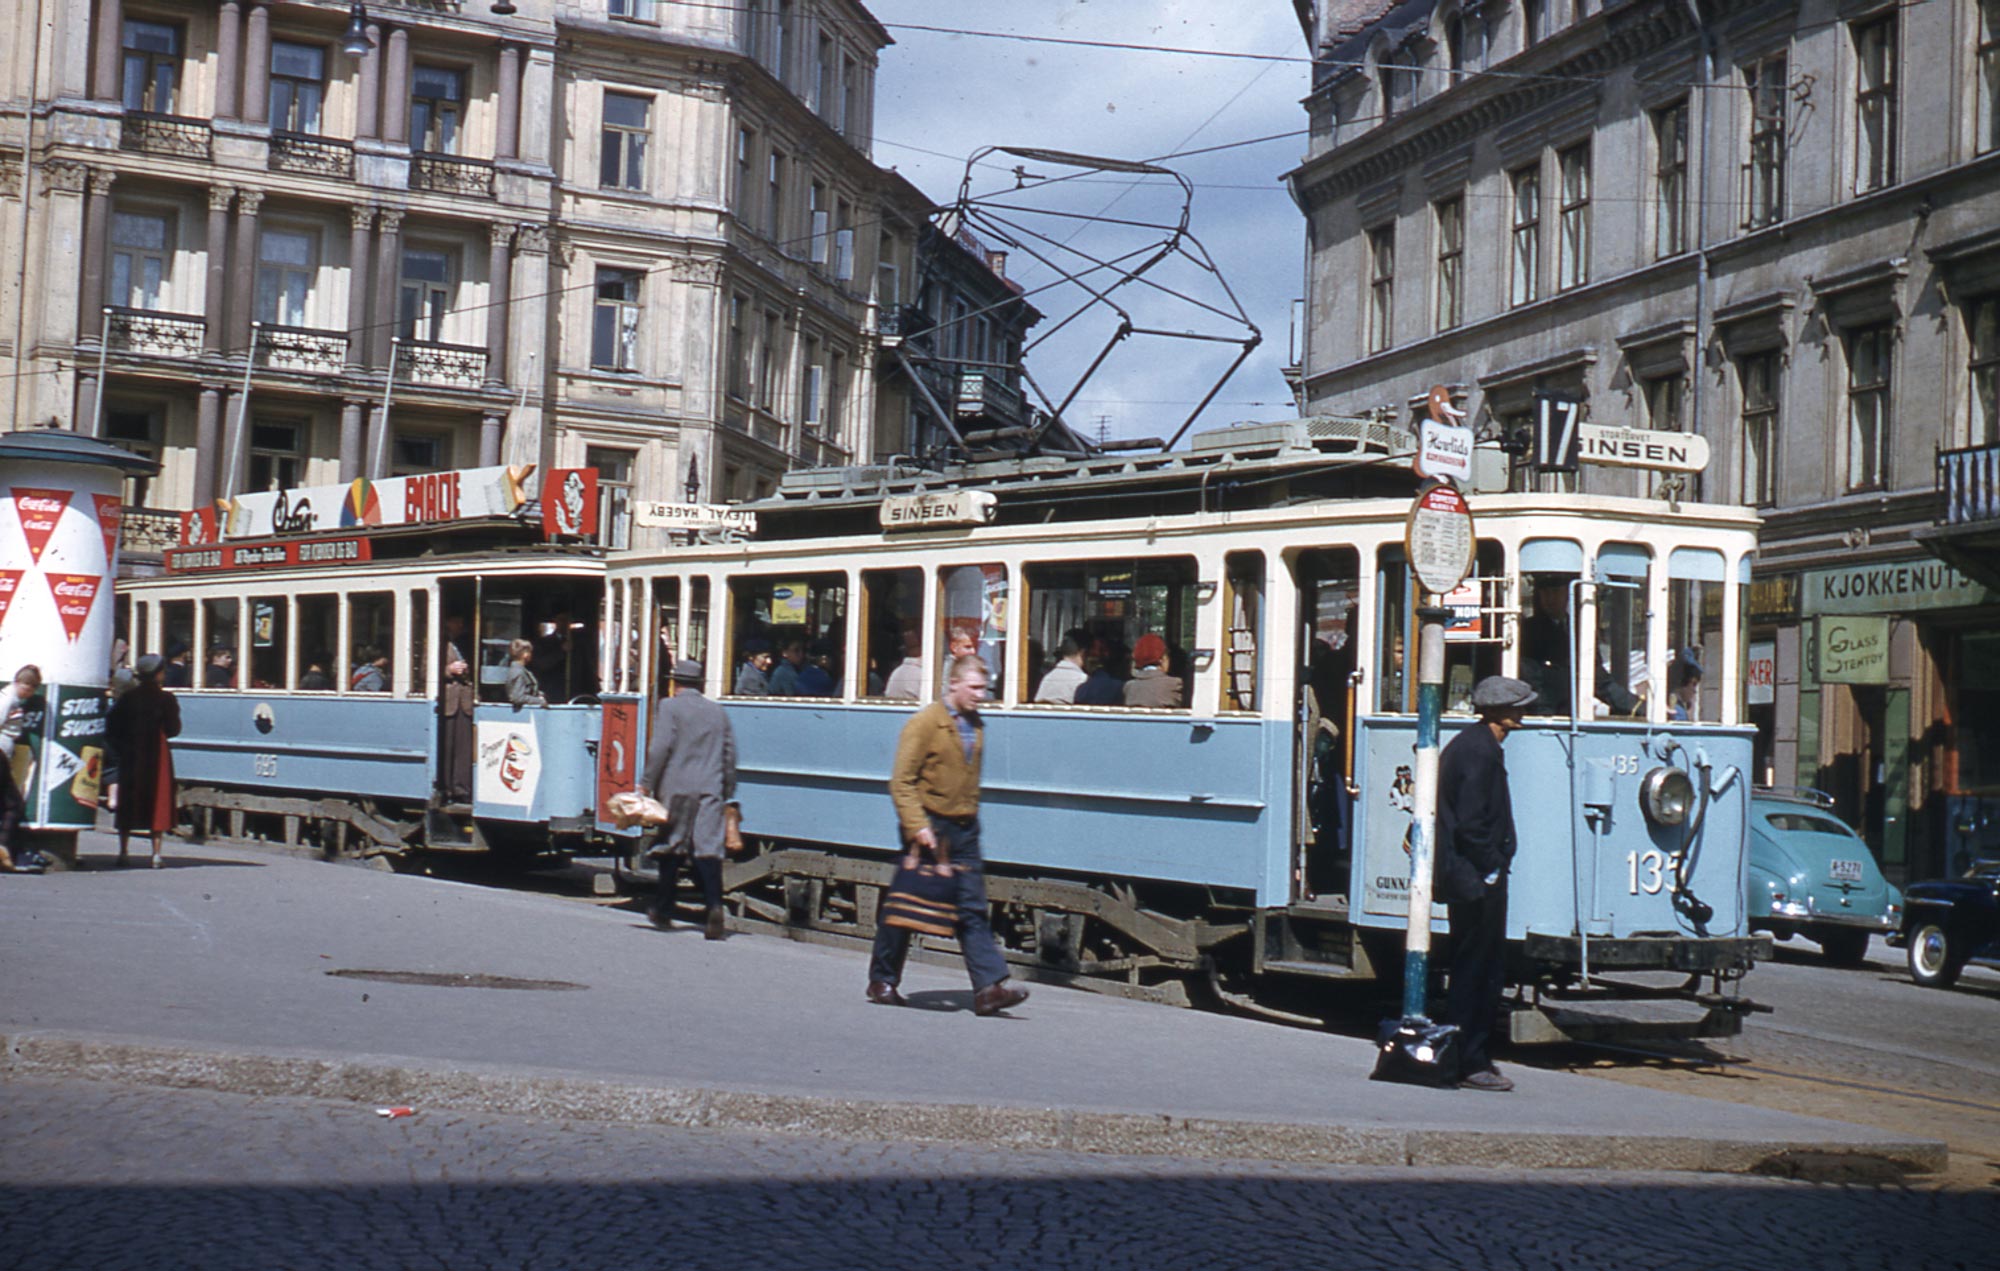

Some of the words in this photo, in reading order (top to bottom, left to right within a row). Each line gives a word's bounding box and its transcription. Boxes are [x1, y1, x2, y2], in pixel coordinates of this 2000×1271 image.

[1540, 399, 1578, 466] 17
[1600, 430, 1651, 442] STORTORVET
[649, 505, 699, 518] HAGEBY
[891, 503, 958, 520] SINSEN
[54, 581, 94, 597] Coca-Cola
[1749, 659, 1773, 686] KER
[1627, 850, 1687, 895] 135
